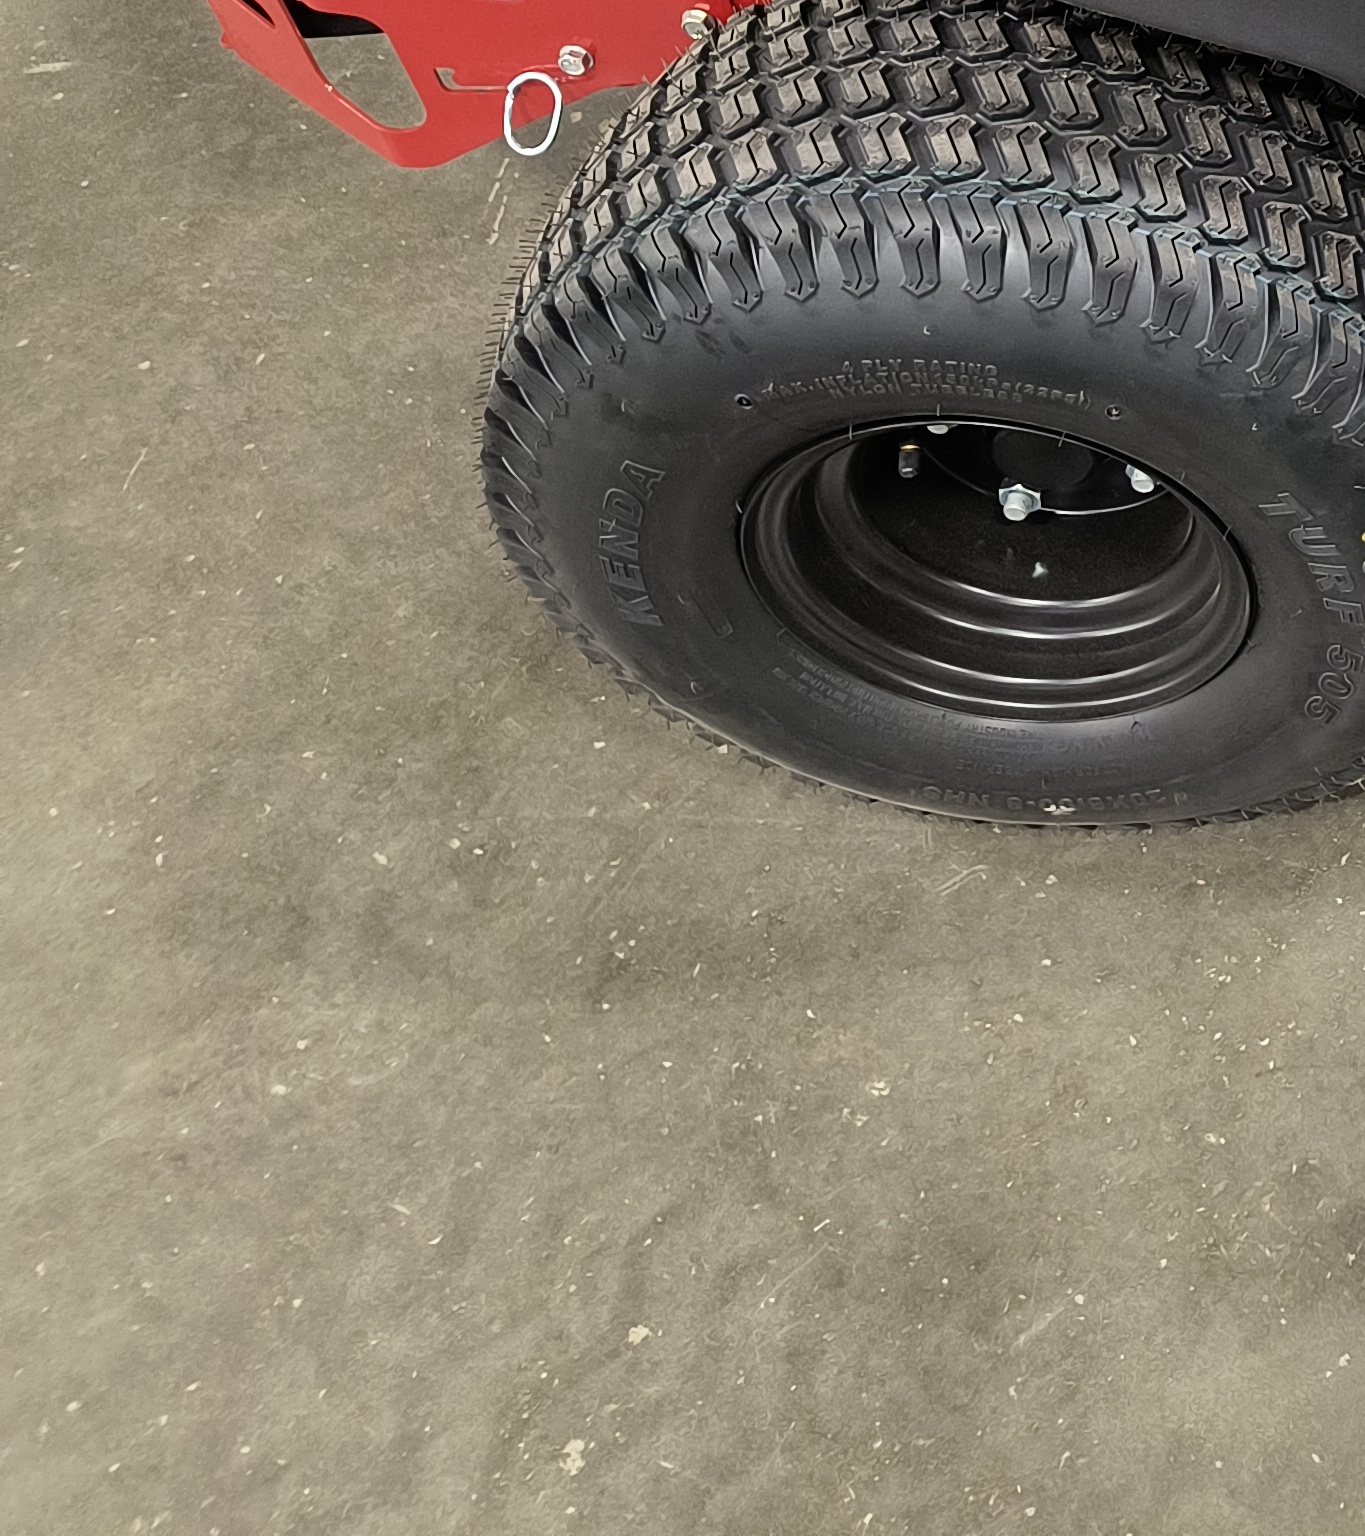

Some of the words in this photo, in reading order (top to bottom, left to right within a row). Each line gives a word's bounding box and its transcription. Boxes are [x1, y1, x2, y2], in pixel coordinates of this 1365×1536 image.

[829, 383, 902, 399] NYLON
[909, 383, 1023, 403] TUBELESS
[861, 359, 902, 372] PLY
[913, 359, 998, 376] RATING
[599, 458, 666, 628] KENDA
[1257, 491, 1365, 626] TURF
[1304, 641, 1365, 728] 505
[921, 785, 989, 807] NHS
